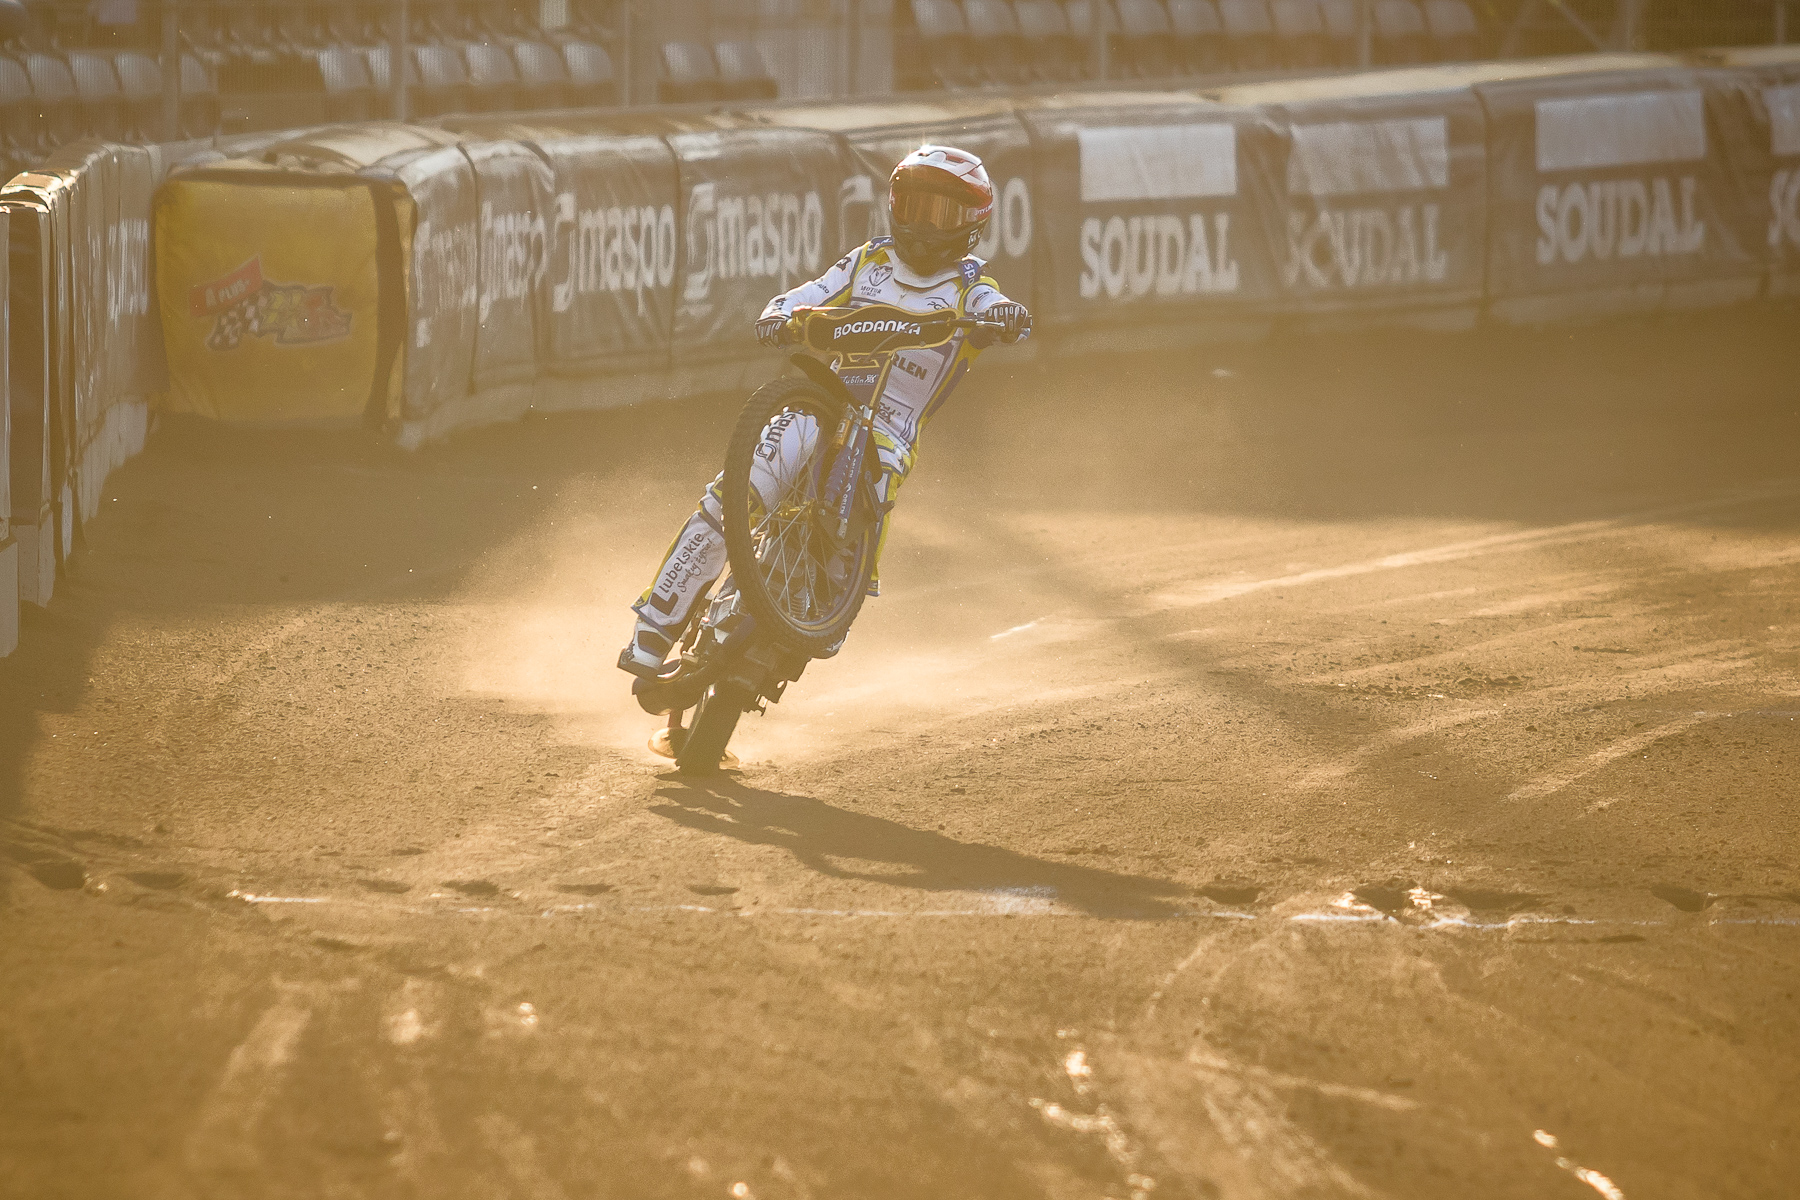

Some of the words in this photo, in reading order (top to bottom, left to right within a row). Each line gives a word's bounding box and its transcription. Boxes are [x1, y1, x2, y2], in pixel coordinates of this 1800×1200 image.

[1536, 177, 1705, 265] SOUDAL
[1079, 213, 1240, 299] SOUDAL
[833, 320, 921, 340] BOGDANKA
[892, 353, 928, 381] RLEN
[658, 533, 705, 594] lubelskie
